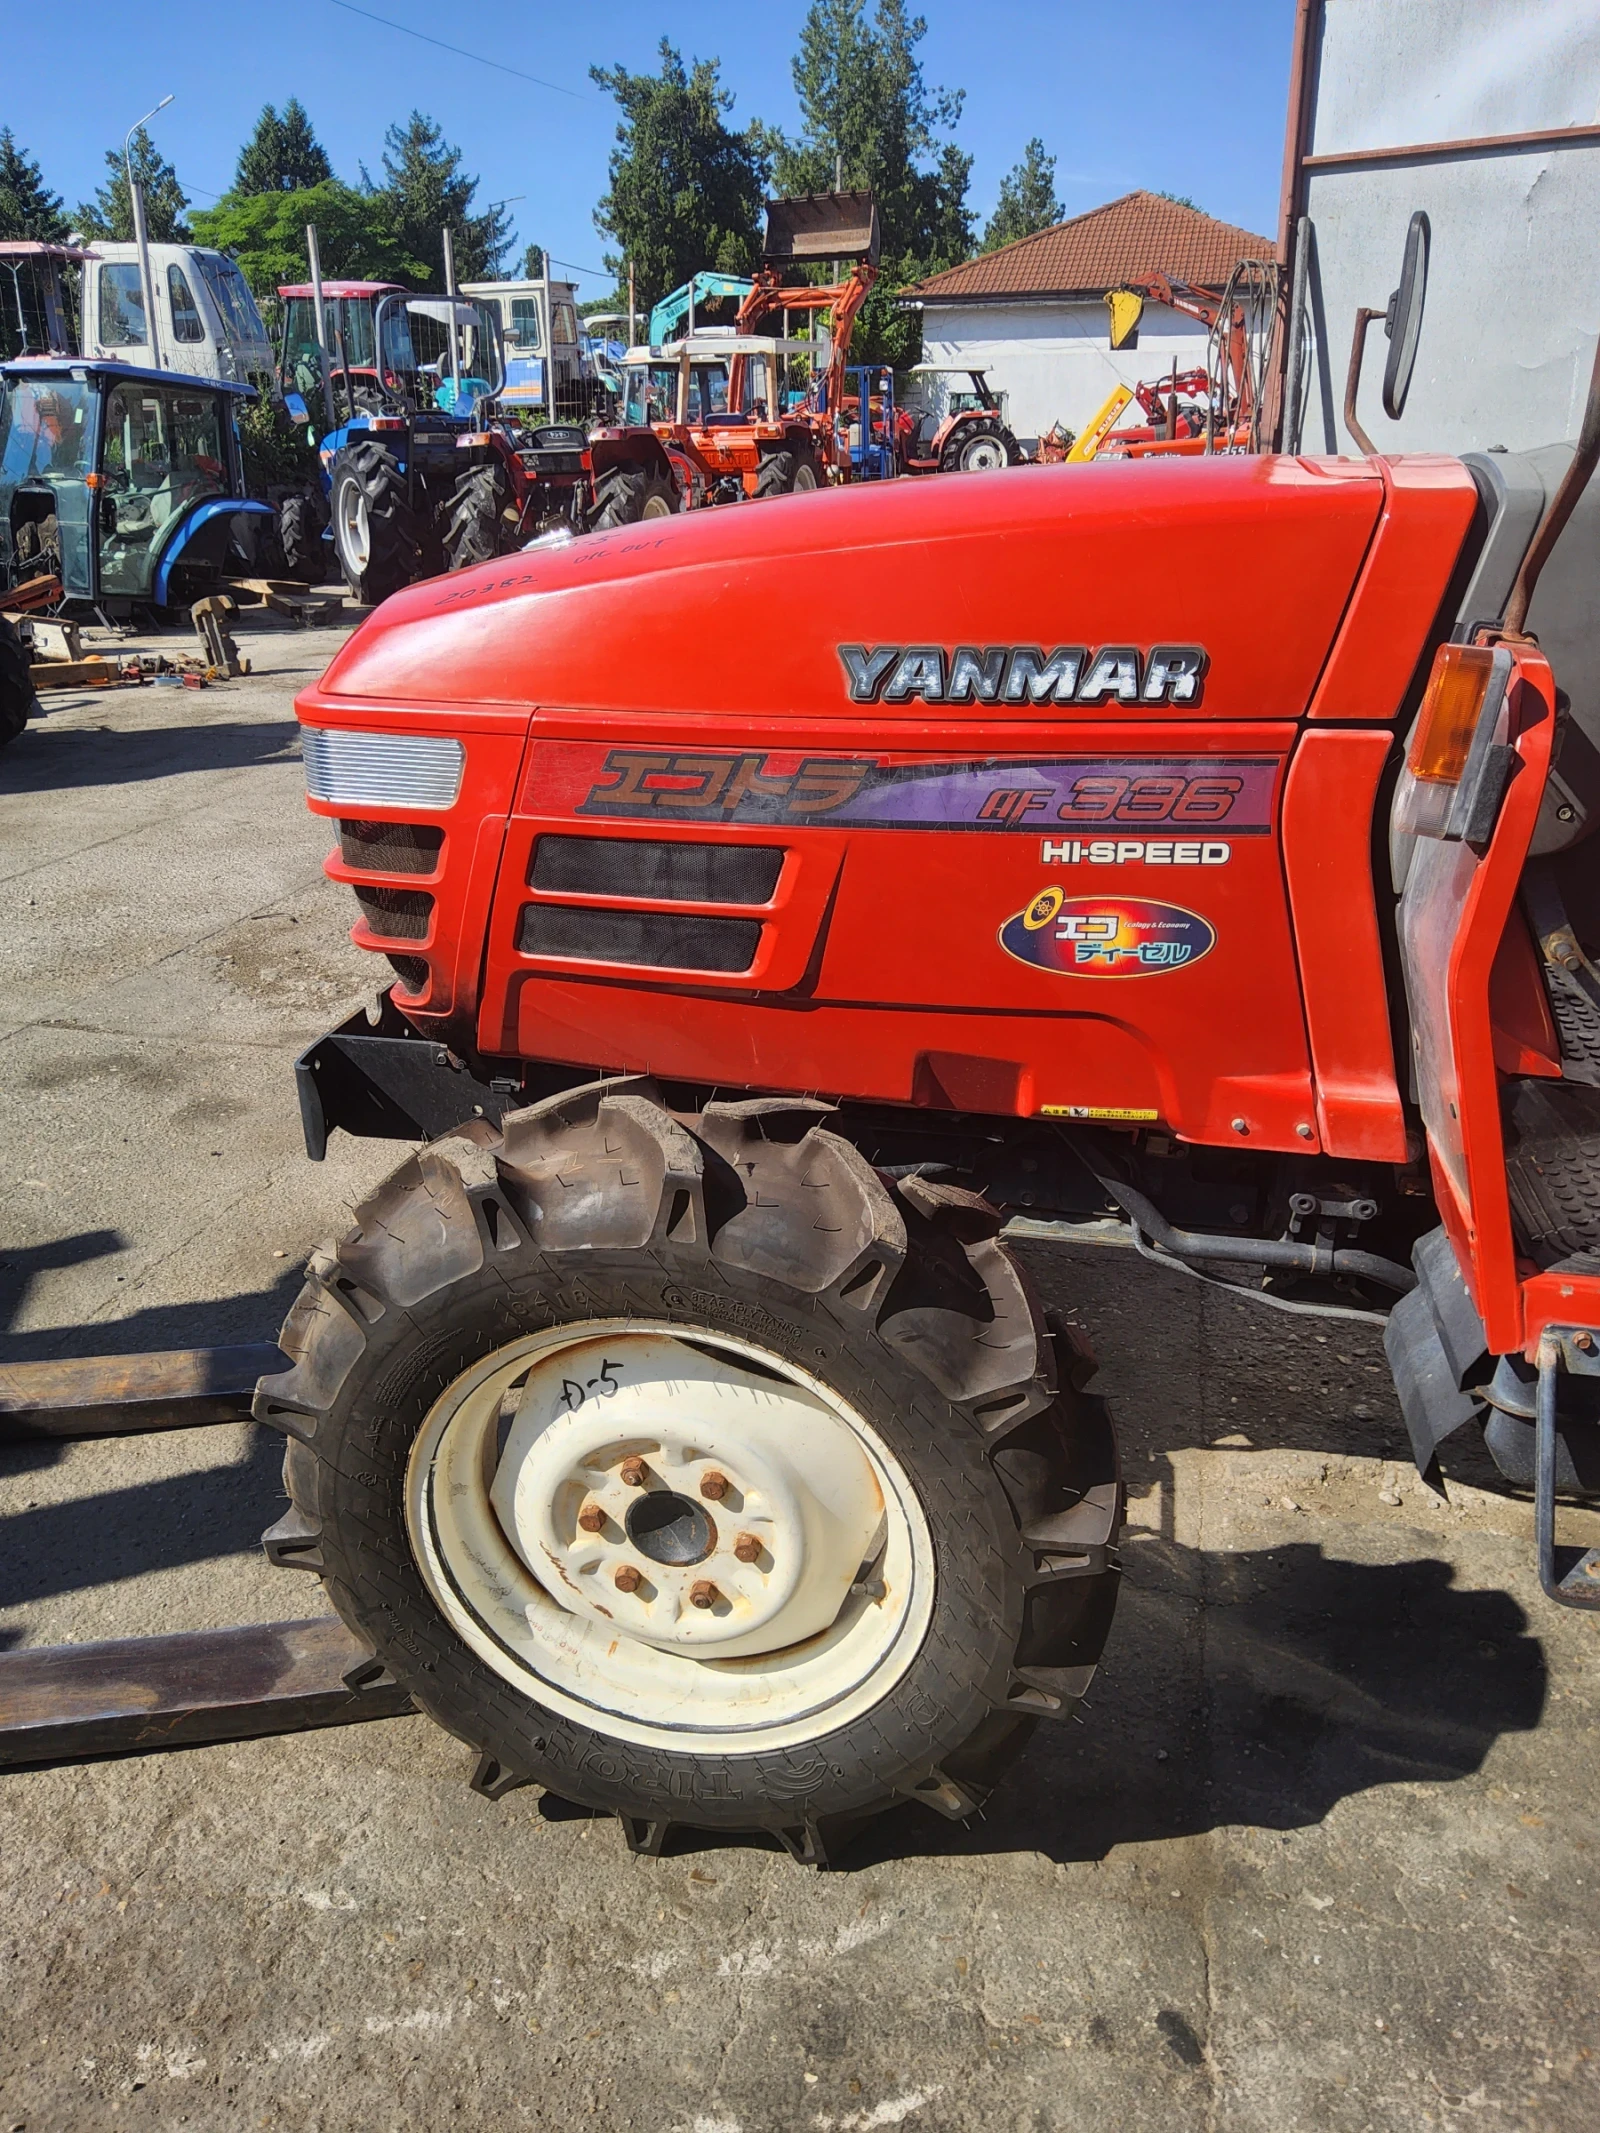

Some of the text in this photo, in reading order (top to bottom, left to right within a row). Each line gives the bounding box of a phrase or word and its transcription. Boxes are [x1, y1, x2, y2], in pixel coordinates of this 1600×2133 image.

[838, 645, 1208, 706] YANMAR
[590, 752, 870, 814] エコトラ
[978, 775, 1244, 826] AF 336
[1041, 840, 1231, 865] HI-SPEED
[1054, 916, 1119, 941] エコ
[1123, 921, 1151, 931] Ecology
[1157, 921, 1191, 930] Economy
[1075, 942, 1192, 964] ディーゼル
[560, 1358, 625, 1413] D-5
